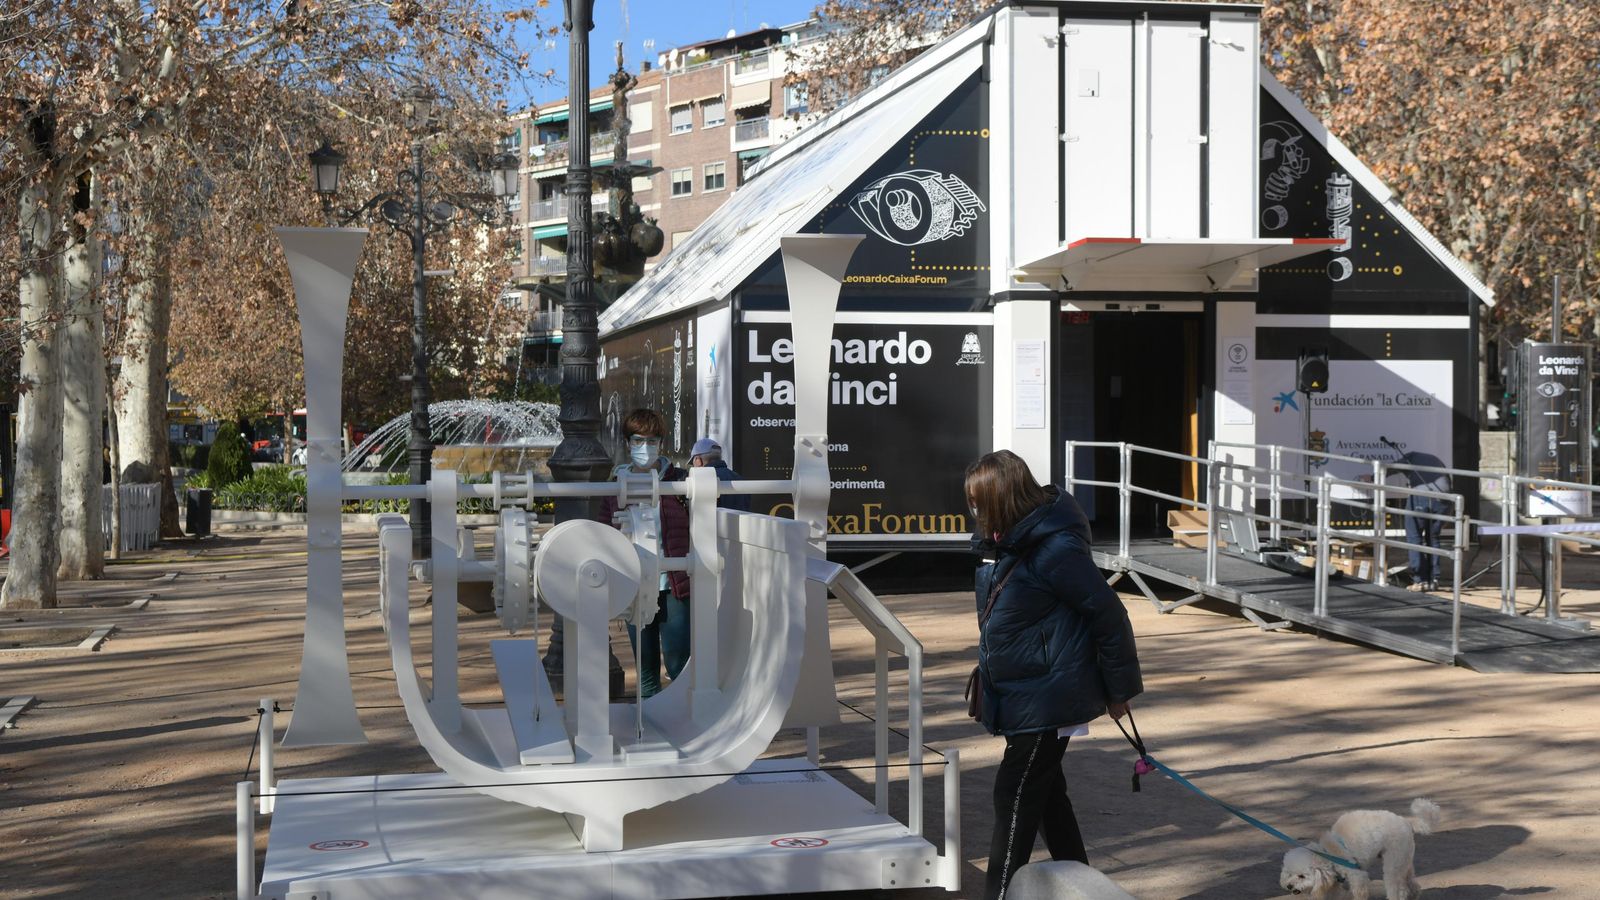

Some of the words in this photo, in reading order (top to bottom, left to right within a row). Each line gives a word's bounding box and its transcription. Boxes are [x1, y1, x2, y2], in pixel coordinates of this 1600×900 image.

[748, 329, 932, 365] Lenardo
[1539, 355, 1584, 365] Leonardo
[1539, 366, 1553, 375] da
[1554, 366, 1579, 375] Vinci
[747, 371, 796, 405] da
[828, 372, 897, 405] inci
[1309, 392, 1374, 407] undación
[750, 416, 797, 427] observa
[829, 478, 886, 490] perimenta
[769, 503, 967, 534] xaForum
